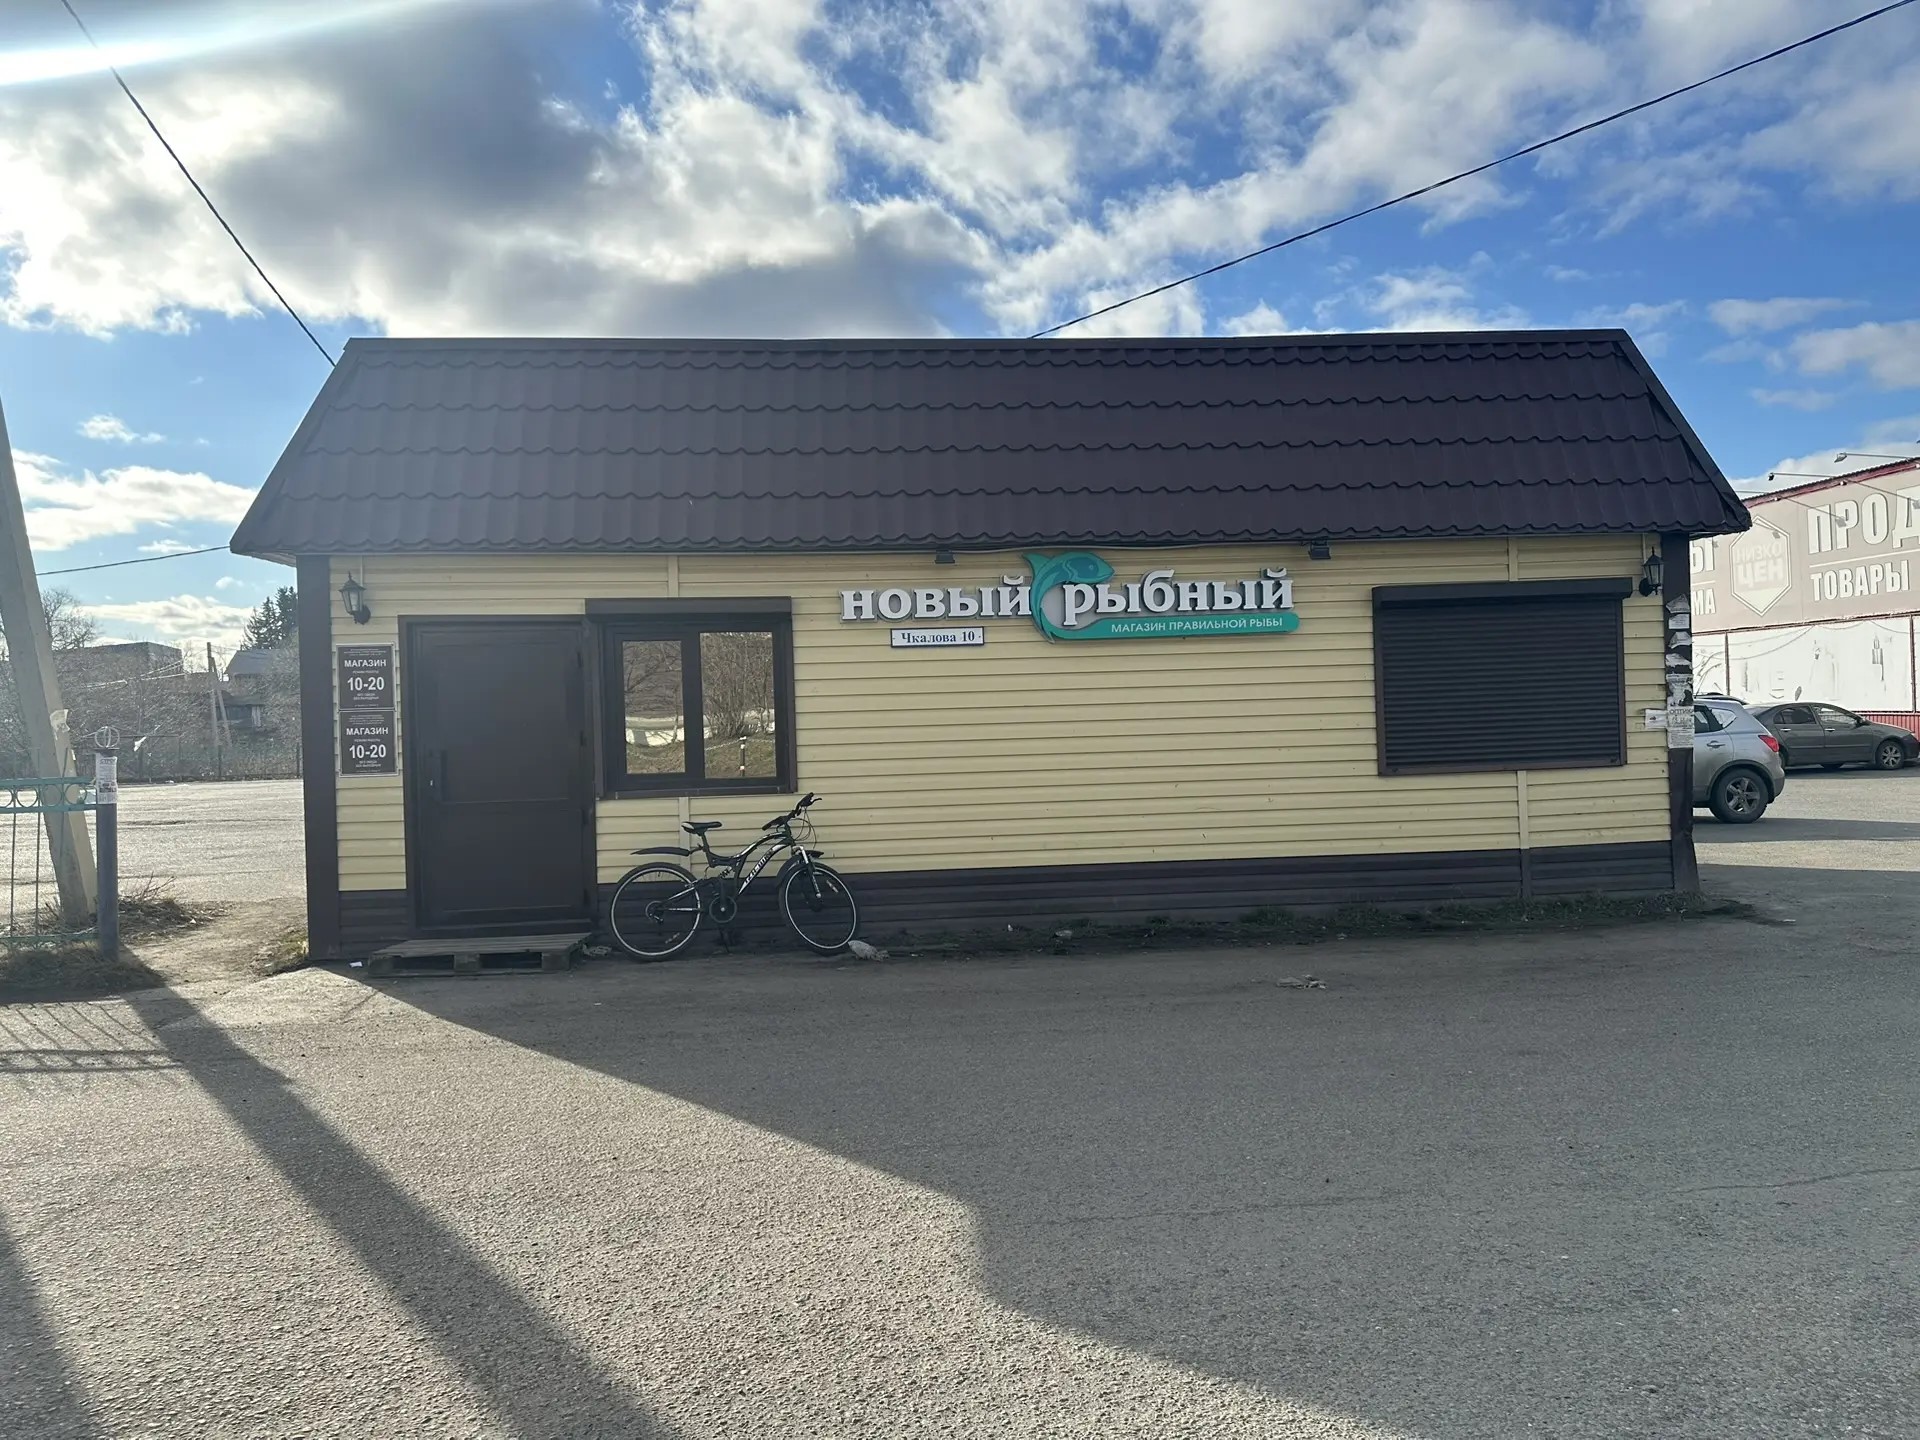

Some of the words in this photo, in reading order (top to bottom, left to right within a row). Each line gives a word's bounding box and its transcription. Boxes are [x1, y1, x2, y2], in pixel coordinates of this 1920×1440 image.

[1807, 484, 1920, 554] ПРОД
[1737, 557, 1784, 588] ЦЕН
[1810, 560, 1910, 601] ТОВАРЫ
[1111, 622, 1166, 633] МАГАЗИН
[1169, 618, 1247, 630] ПРАВИЛЬНОЙ
[1250, 617, 1283, 628] РЫБЫ
[901, 632, 957, 644] Чкалова
[961, 631, 975, 642] 10
[344, 659, 387, 667] МАГАЗИН
[347, 676, 385, 691] 10-20
[346, 727, 389, 736] МАГАЗИН
[349, 744, 387, 759] 10-20
